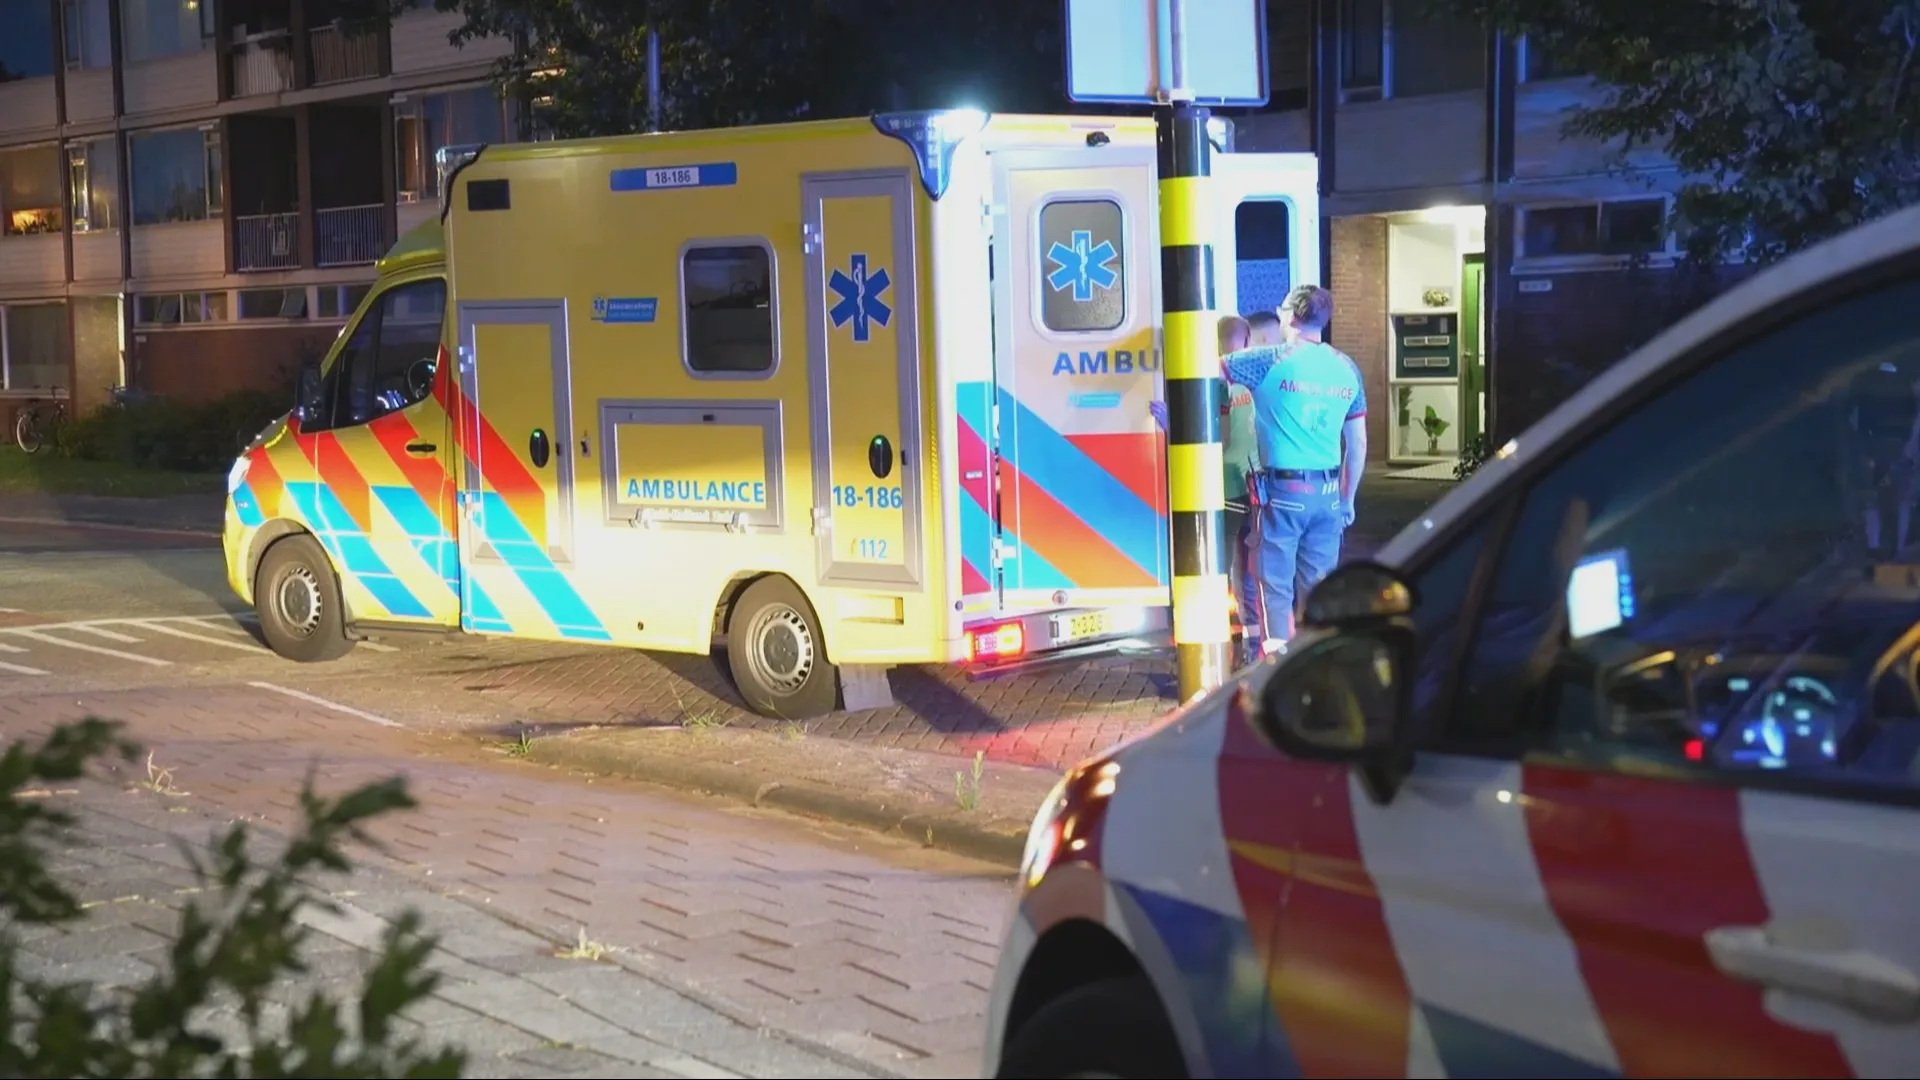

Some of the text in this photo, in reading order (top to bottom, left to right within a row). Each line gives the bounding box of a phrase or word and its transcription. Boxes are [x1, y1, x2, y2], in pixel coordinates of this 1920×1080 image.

[655, 170, 691, 185] 18-186
[1052, 350, 1159, 376] AMBU
[627, 478, 765, 503] AMBULANCE
[833, 485, 904, 509] 18-186
[860, 538, 887, 559] 112
